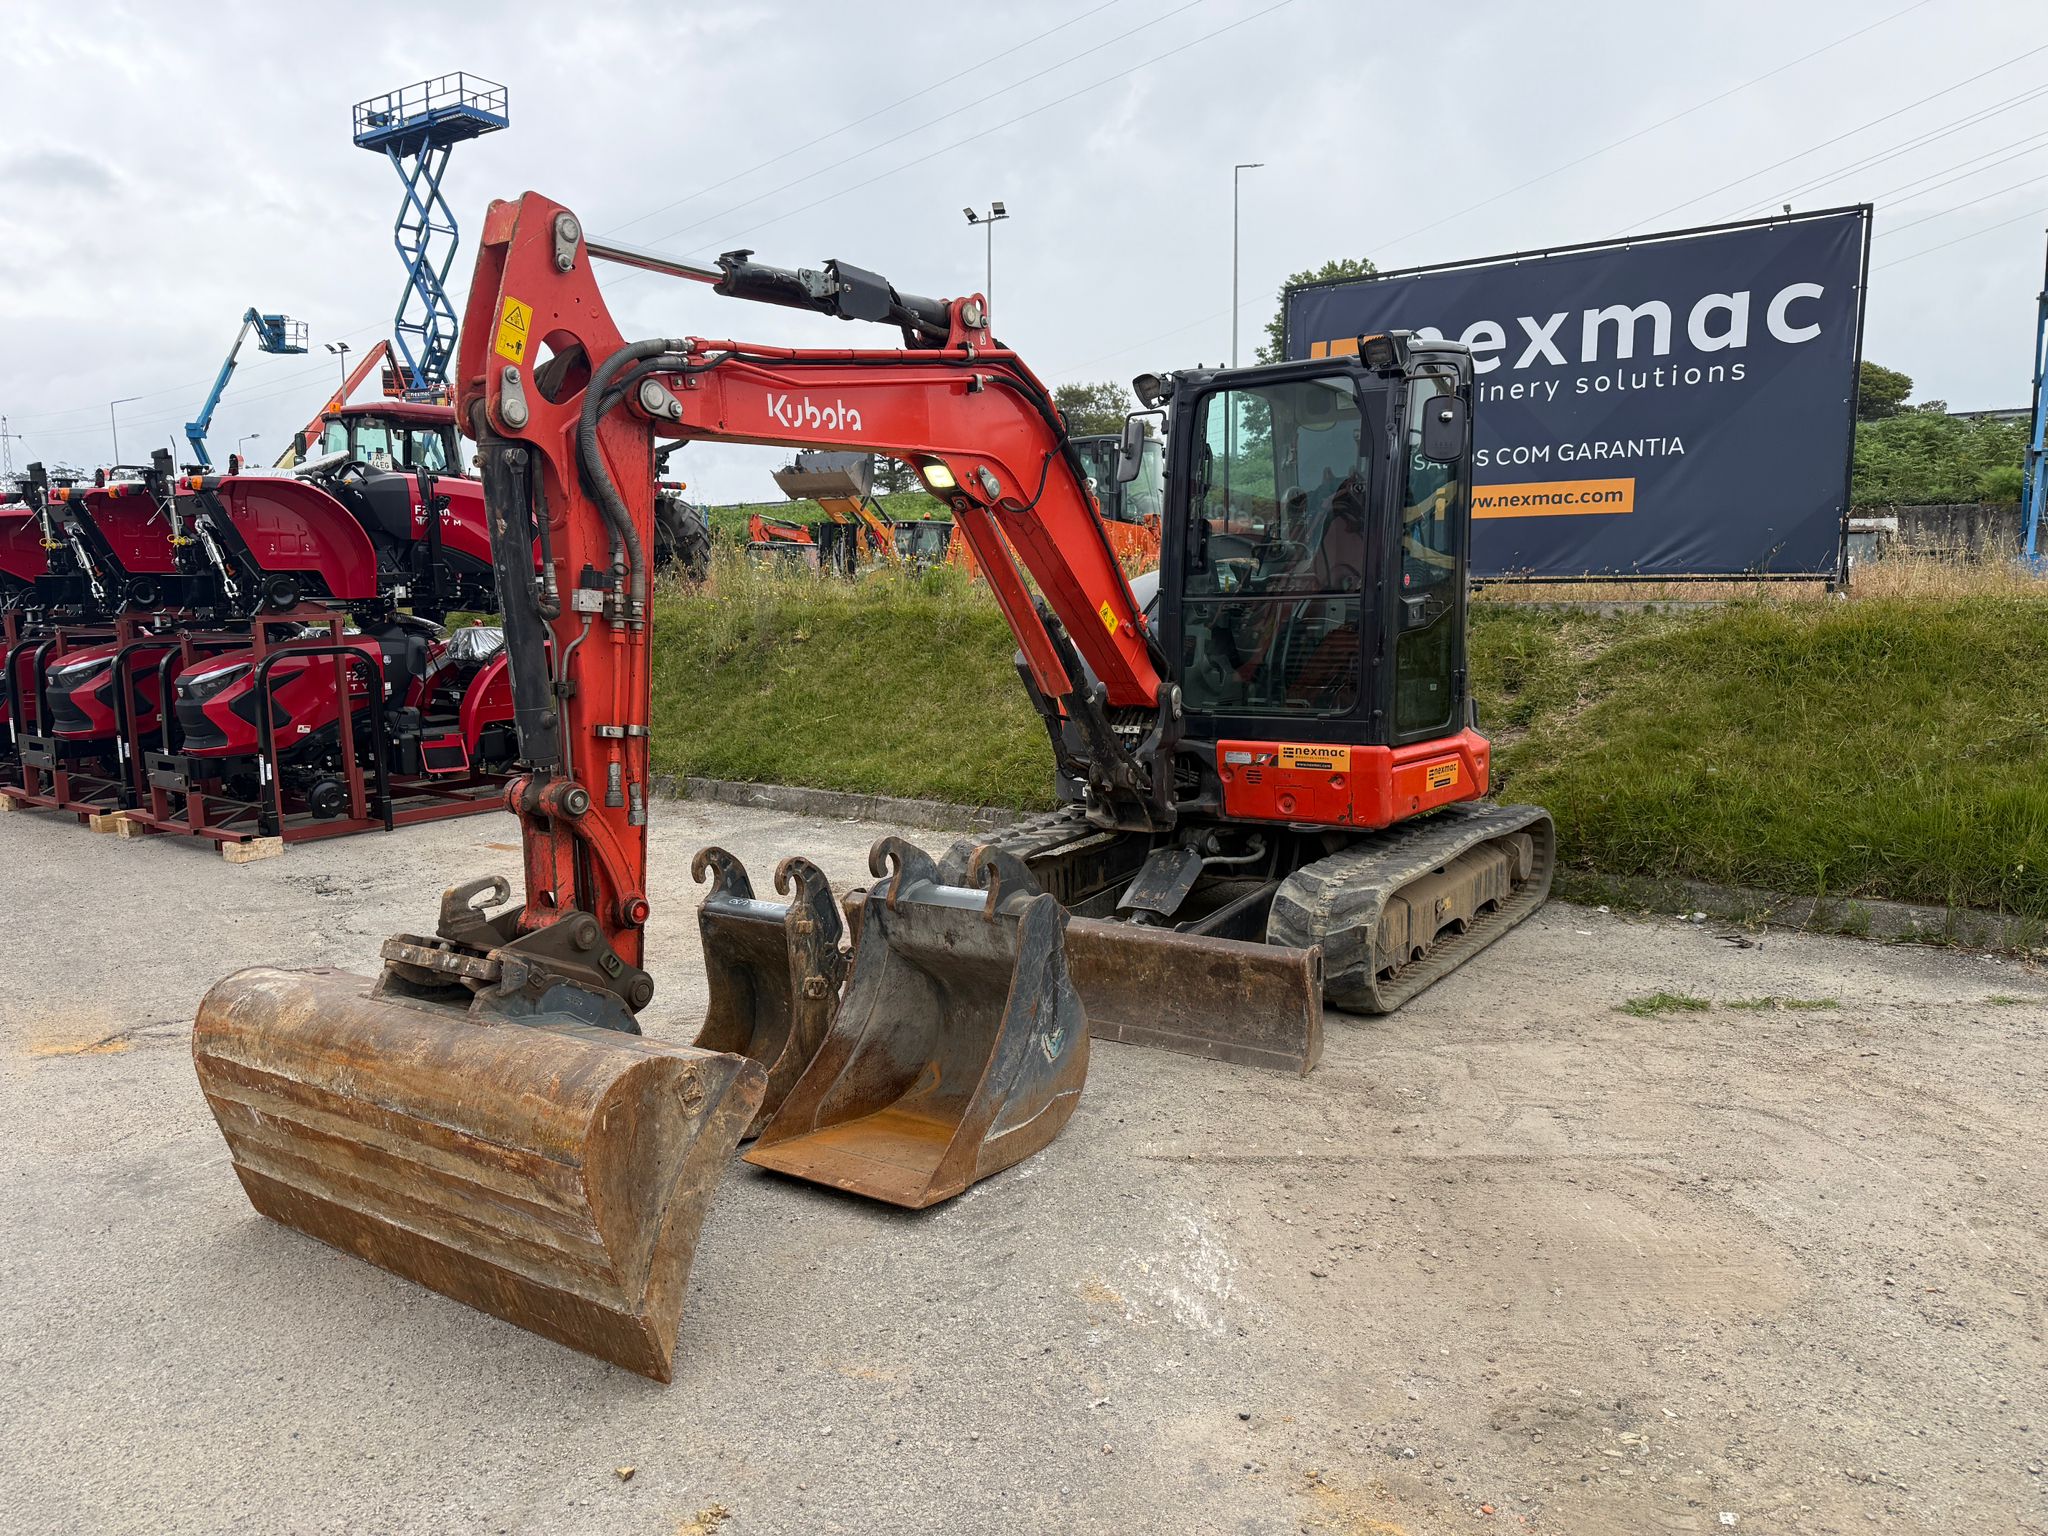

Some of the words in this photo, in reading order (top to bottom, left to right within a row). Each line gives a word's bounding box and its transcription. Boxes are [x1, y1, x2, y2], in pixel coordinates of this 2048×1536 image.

[1411, 283, 1824, 374] exmac
[1480, 379, 1560, 402] inery
[1576, 363, 1746, 394] solutions
[767, 393, 862, 431] Kubota
[1496, 445, 1550, 465] COM
[1558, 436, 1685, 461] GARANTIA
[1472, 490, 1623, 509] w.nexmac.com
[1295, 747, 1345, 758] nexmac
